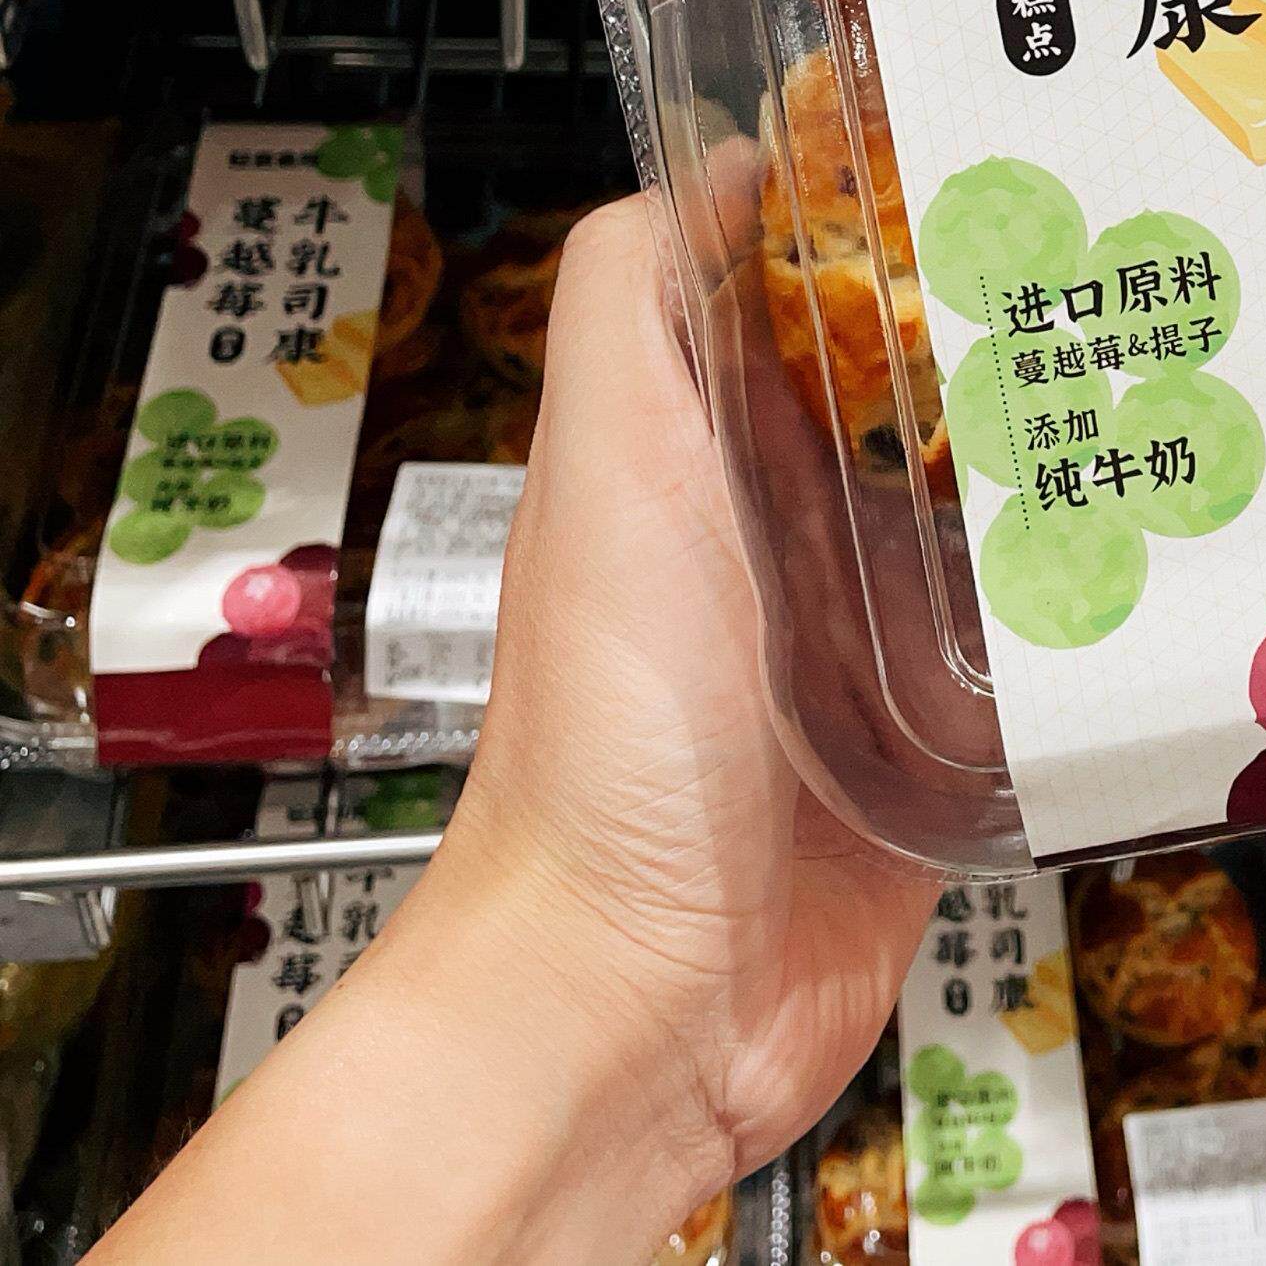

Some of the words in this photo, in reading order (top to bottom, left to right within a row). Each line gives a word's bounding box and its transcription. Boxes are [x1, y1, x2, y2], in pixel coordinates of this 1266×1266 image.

[1001, 252, 1223, 338] 进口原料
[1011, 317, 1223, 388] 蔓越莓&提子
[1023, 409, 1101, 452] 添加
[1033, 438, 1199, 511] 纯牛奶
